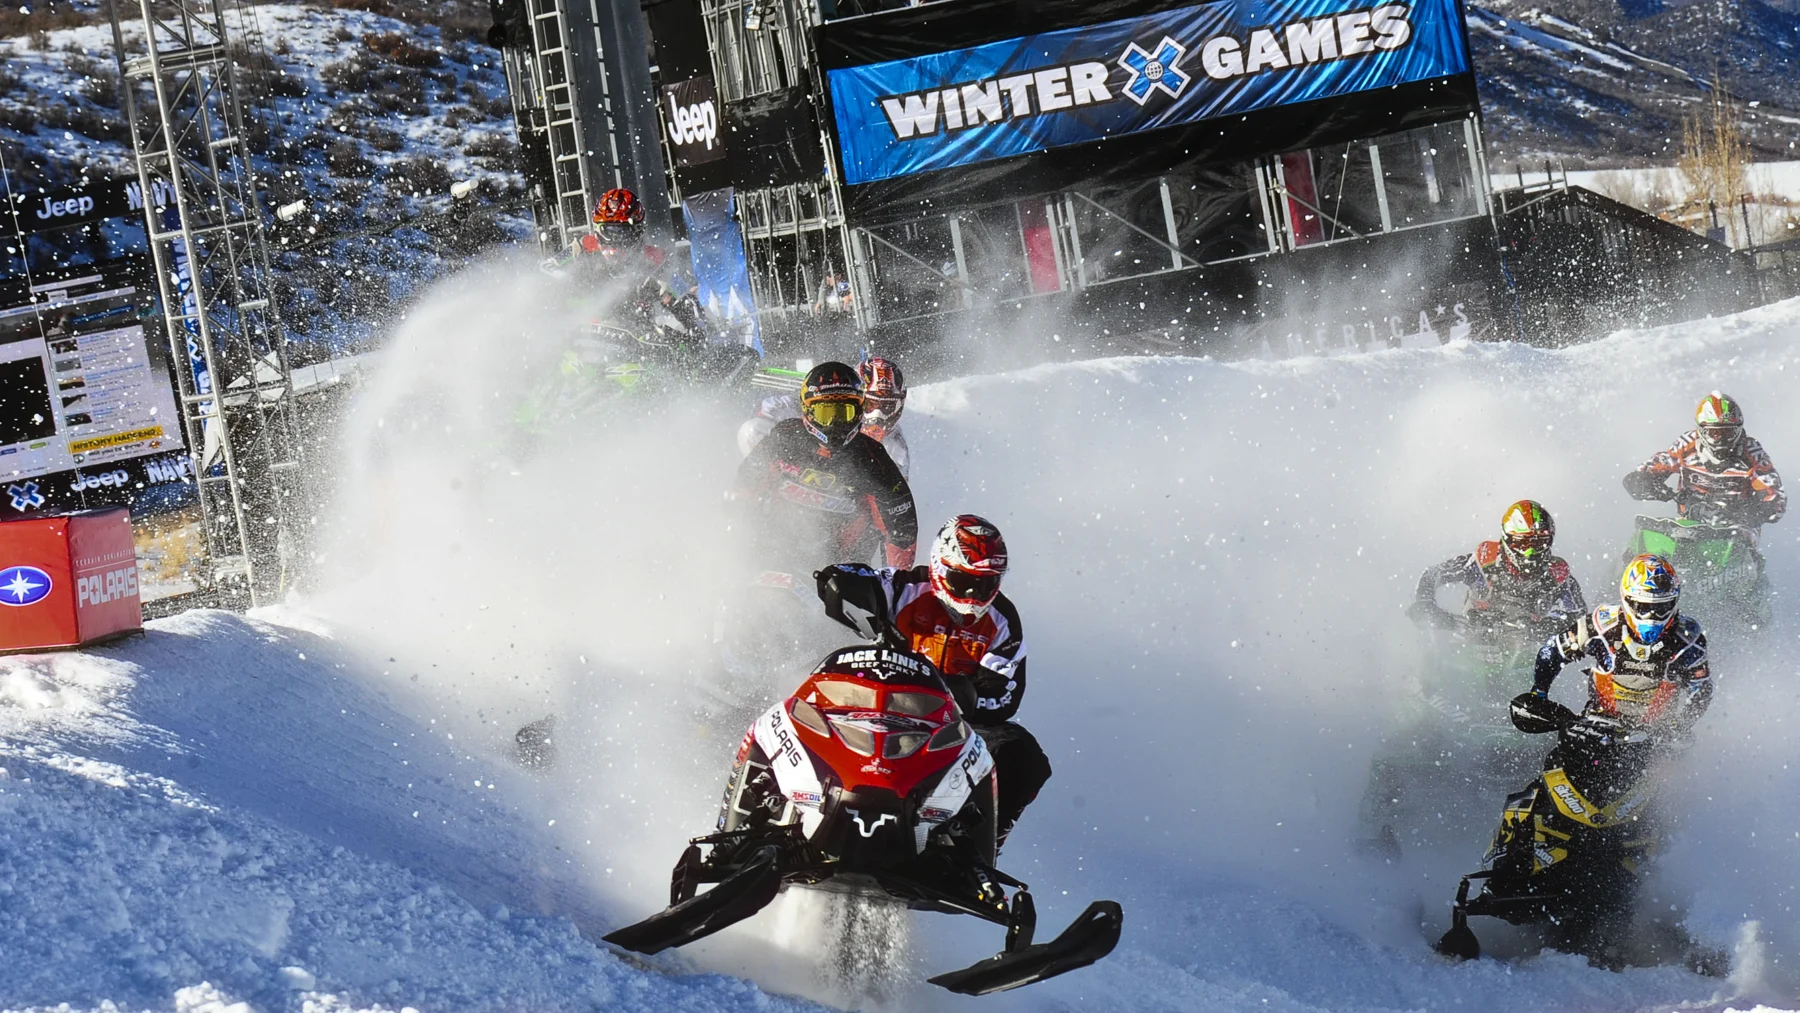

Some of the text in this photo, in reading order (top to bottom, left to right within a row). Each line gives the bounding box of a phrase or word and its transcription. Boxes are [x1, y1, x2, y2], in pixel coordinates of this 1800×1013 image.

[882, 61, 1113, 139] WINTER
[1202, 4, 1411, 79] GAMES
[668, 91, 717, 150] Jeep
[36, 195, 94, 219] Jeep
[70, 468, 129, 492] Jeep
[77, 566, 138, 609] POLARIS
[836, 649, 932, 677] JACK LINK'S
[851, 661, 917, 677] BEEF JERKY
[770, 709, 803, 768] POLARIS
[791, 790, 823, 803] AMSOIL
[1553, 784, 1585, 814] ski-doo
